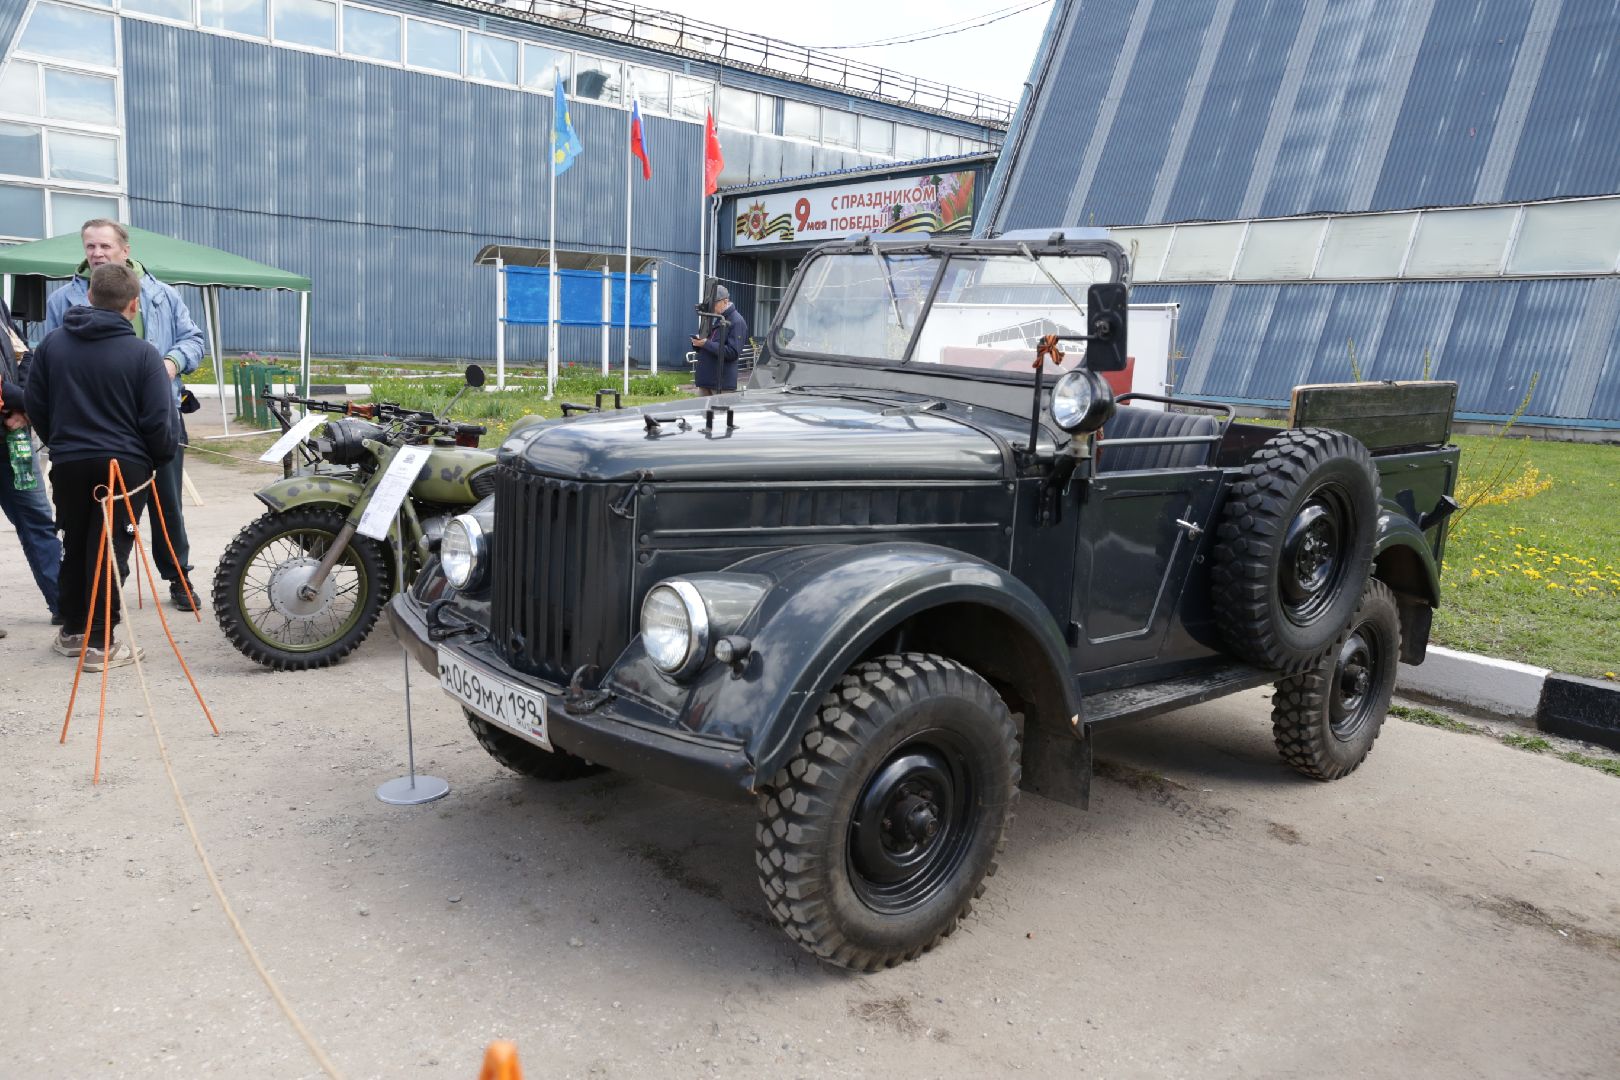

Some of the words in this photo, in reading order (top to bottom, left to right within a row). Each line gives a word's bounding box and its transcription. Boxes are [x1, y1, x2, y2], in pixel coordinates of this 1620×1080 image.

[831, 196, 839, 210] С
[841, 186, 935, 209] ПРАЗДНИКОМ
[795, 197, 811, 232] 9
[830, 213, 888, 231] ПОБЕДЫ!
